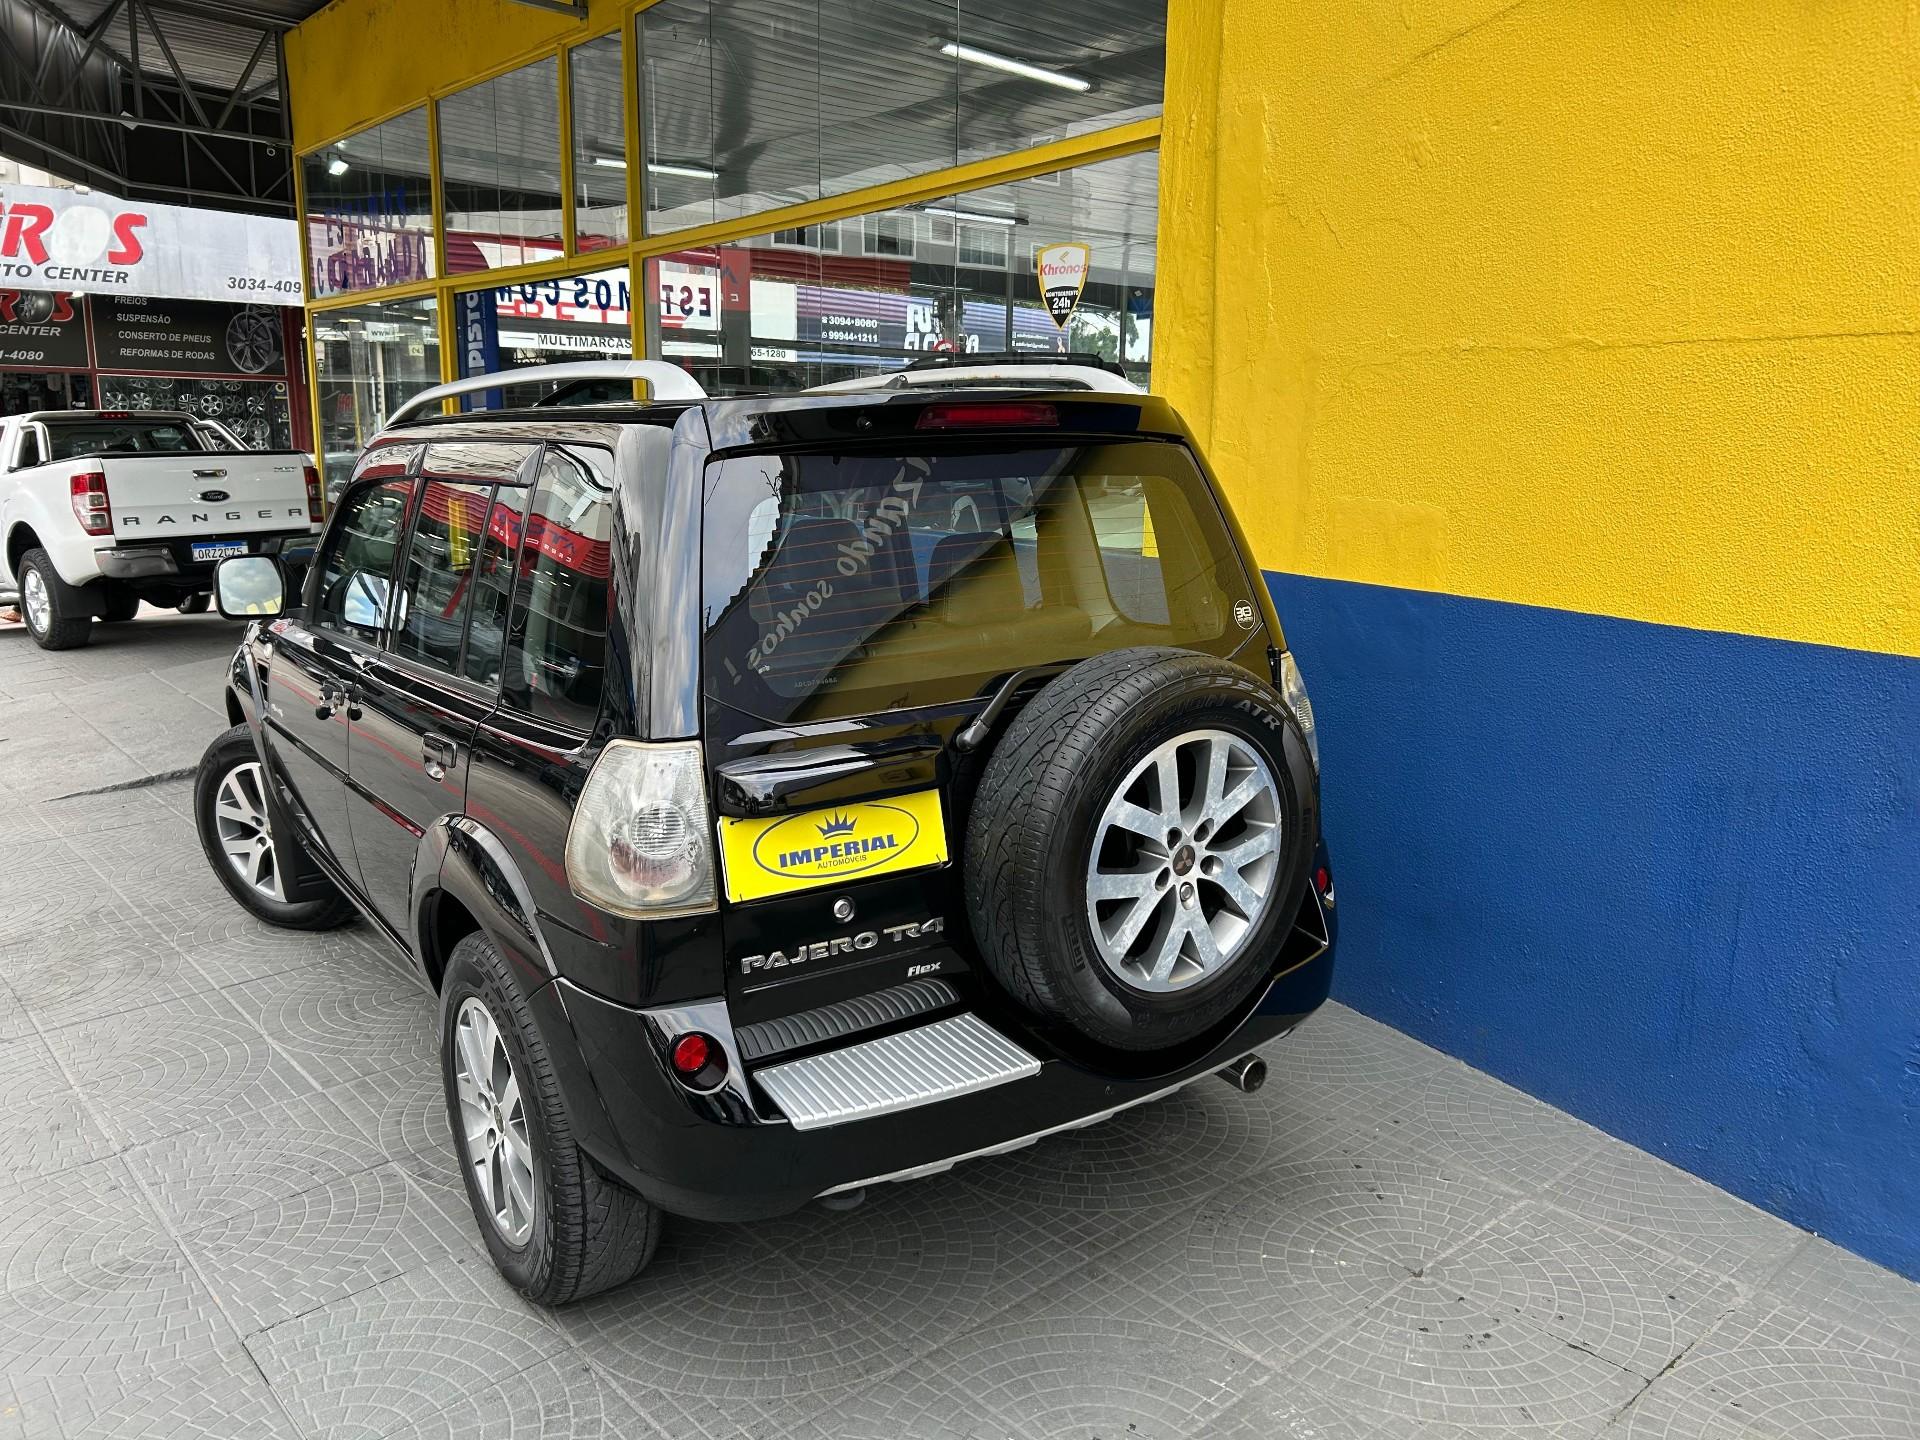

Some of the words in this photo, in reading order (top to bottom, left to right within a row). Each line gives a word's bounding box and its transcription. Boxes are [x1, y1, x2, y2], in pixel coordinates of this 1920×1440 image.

[44, 266, 129, 284] CENTER
[1040, 264, 1087, 276] Khronos
[114, 295, 148, 306] FREIOS
[1052, 297, 1071, 309] 24h
[116, 312, 171, 325] SUSPENSÃO
[118, 330, 167, 342] CONSERTO
[169, 333, 181, 342] DE
[183, 334, 212, 344] PNEUS
[538, 333, 632, 350] MULTIMARCAS
[120, 347, 167, 359] REFORMAS
[169, 350, 183, 359] DE
[185, 350, 216, 361] RODAS
[122, 508, 304, 526] RANGER
[1234, 699, 1280, 731] ATR
[778, 833, 900, 869] IMPERIAL
[740, 931, 879, 975] PAJERO
[882, 916, 945, 942] TR4
[906, 960, 942, 978] Flex
